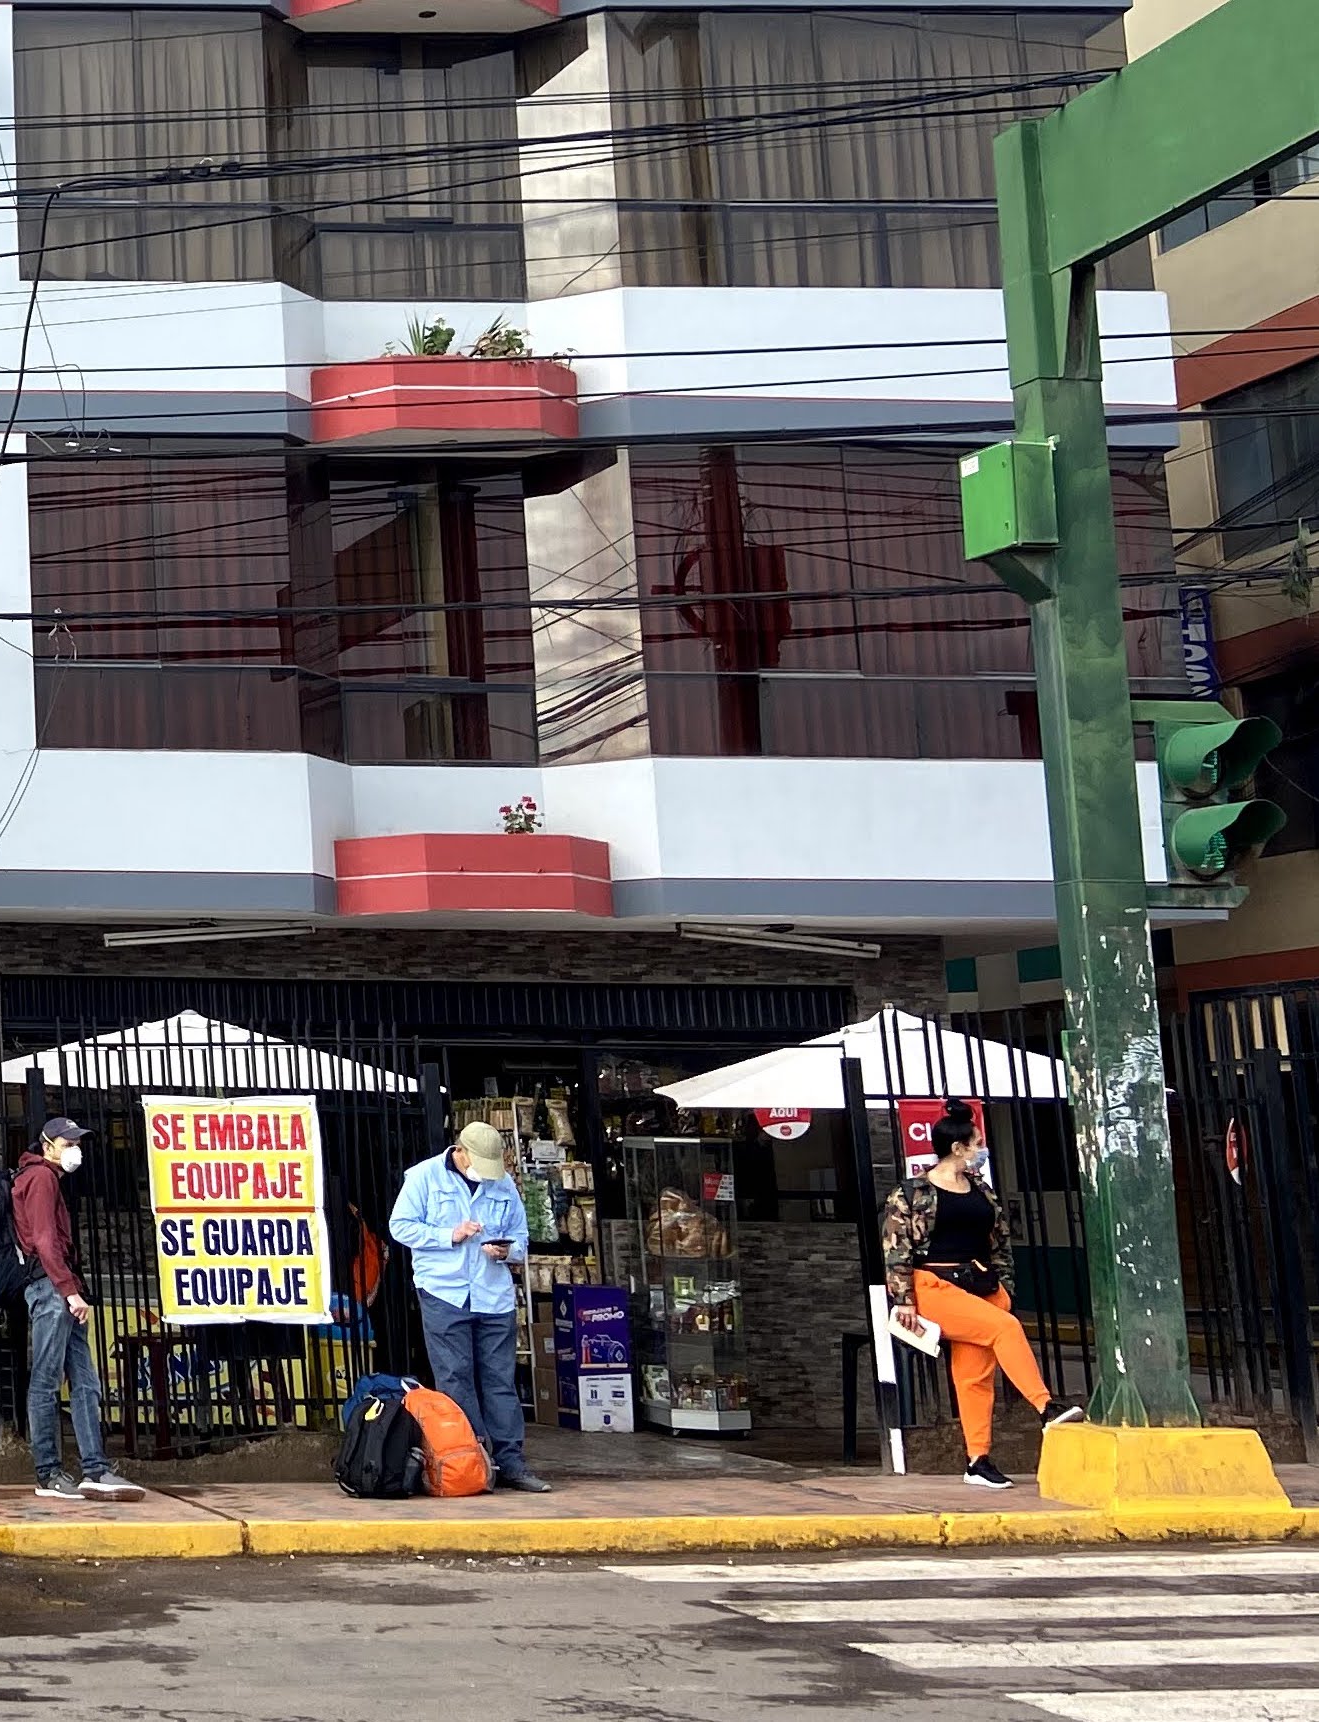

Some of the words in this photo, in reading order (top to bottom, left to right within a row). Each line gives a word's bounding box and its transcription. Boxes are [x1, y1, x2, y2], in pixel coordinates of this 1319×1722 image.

[151, 1113, 187, 1151] SE
[193, 1113, 308, 1151] EMBALA
[171, 1161, 303, 1201] EQUIPAJE
[160, 1218, 196, 1257] SE
[202, 1218, 314, 1256] GUARDA
[174, 1267, 308, 1307] EQUIPAJE
